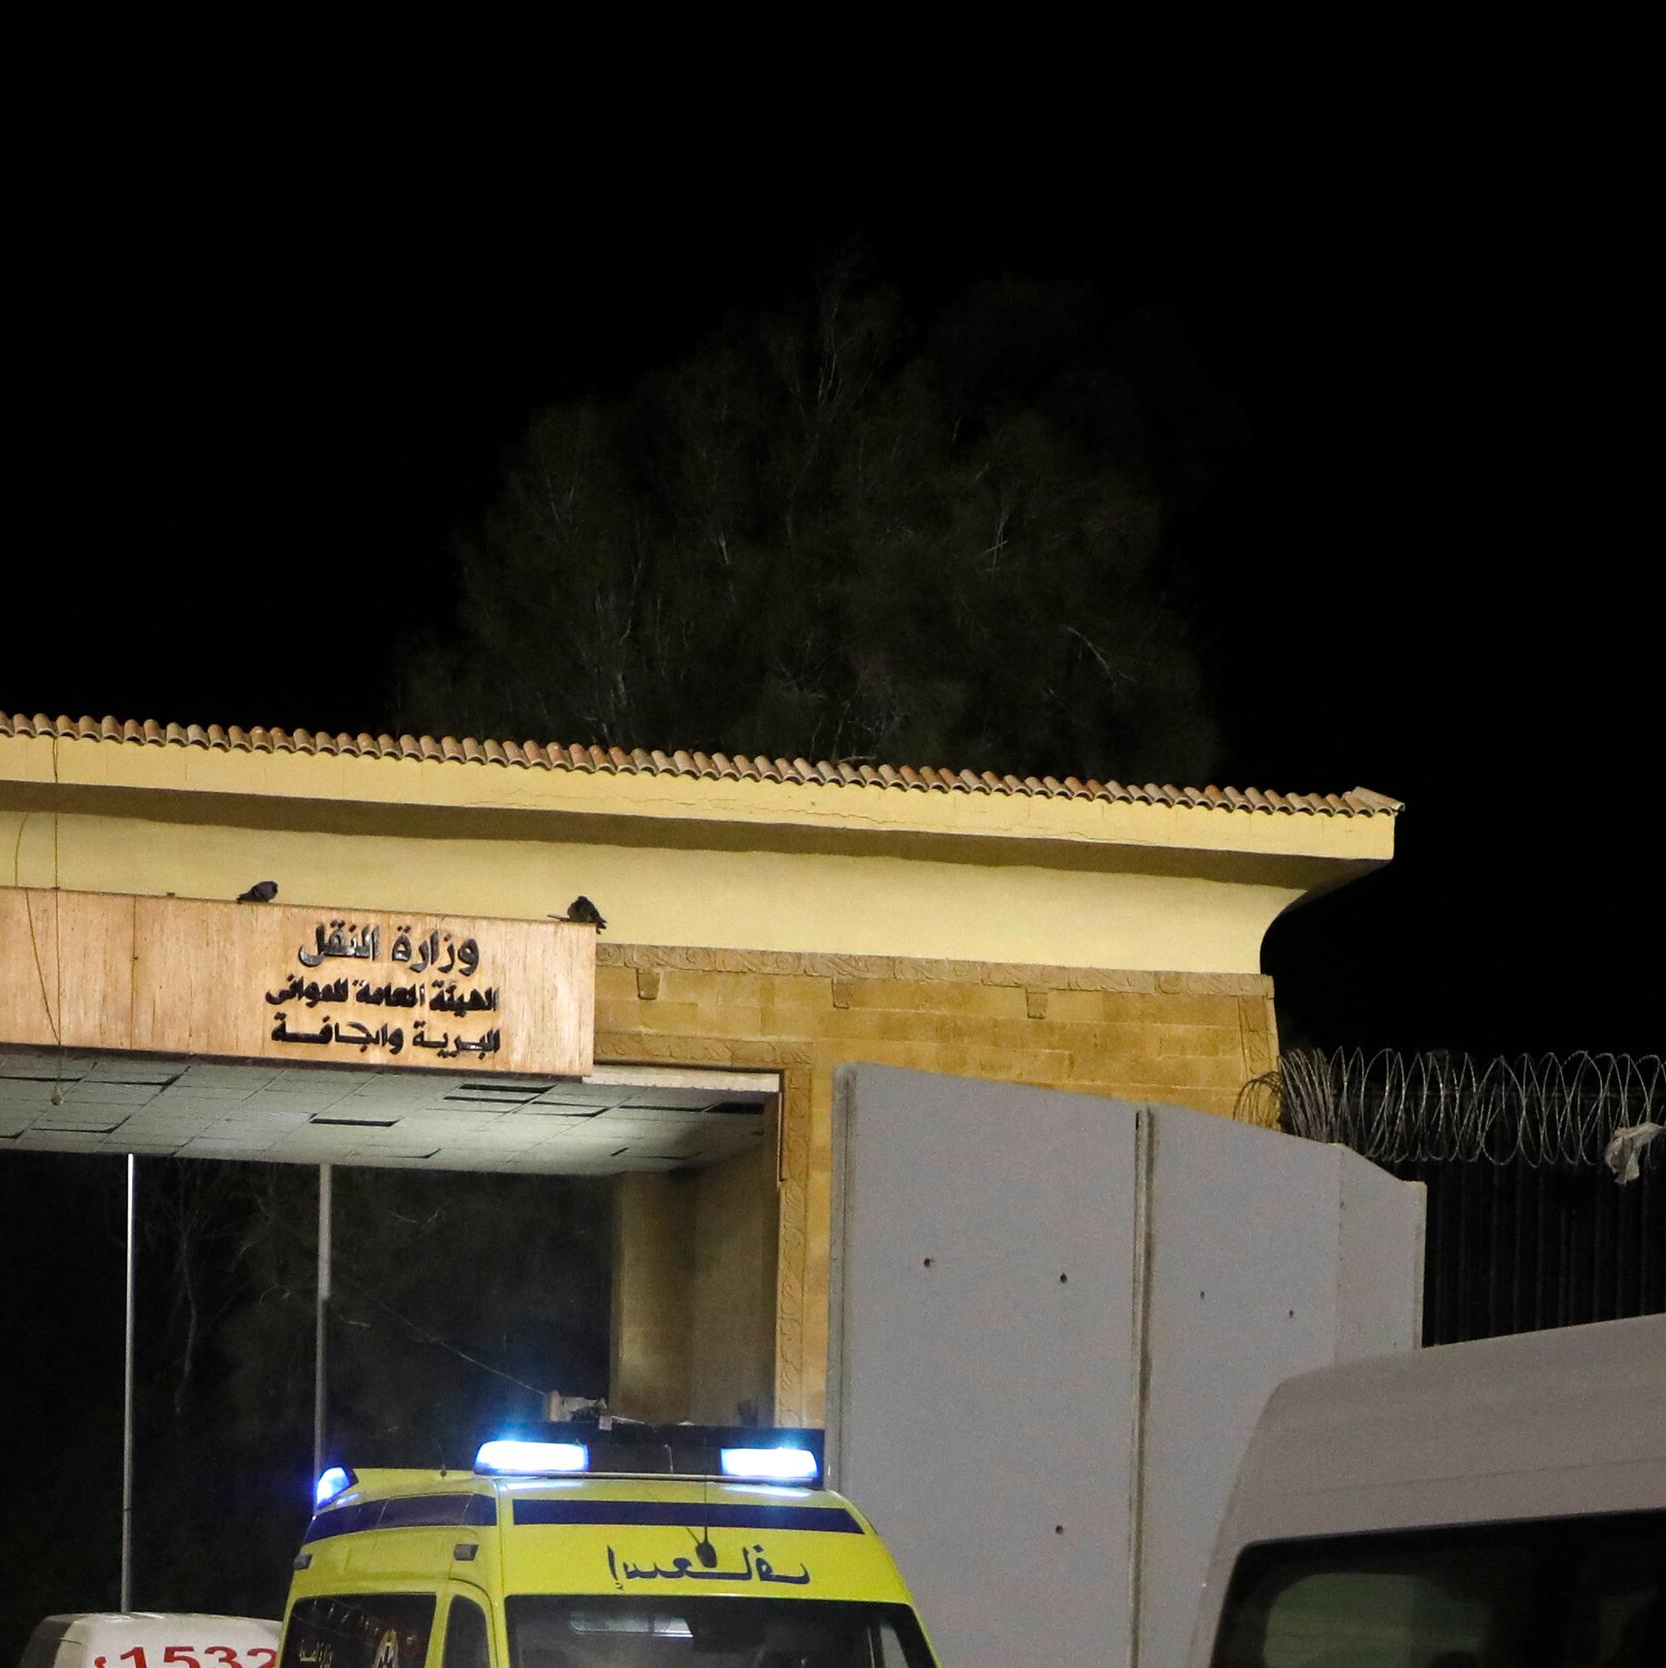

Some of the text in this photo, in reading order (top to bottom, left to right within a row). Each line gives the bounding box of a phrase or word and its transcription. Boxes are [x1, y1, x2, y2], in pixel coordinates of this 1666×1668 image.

[298, 919, 480, 977] وزارة النقل
[351, 978, 426, 1008] العامة
[428, 979, 500, 1018] الهيئة
[412, 1020, 501, 1060] البرية
